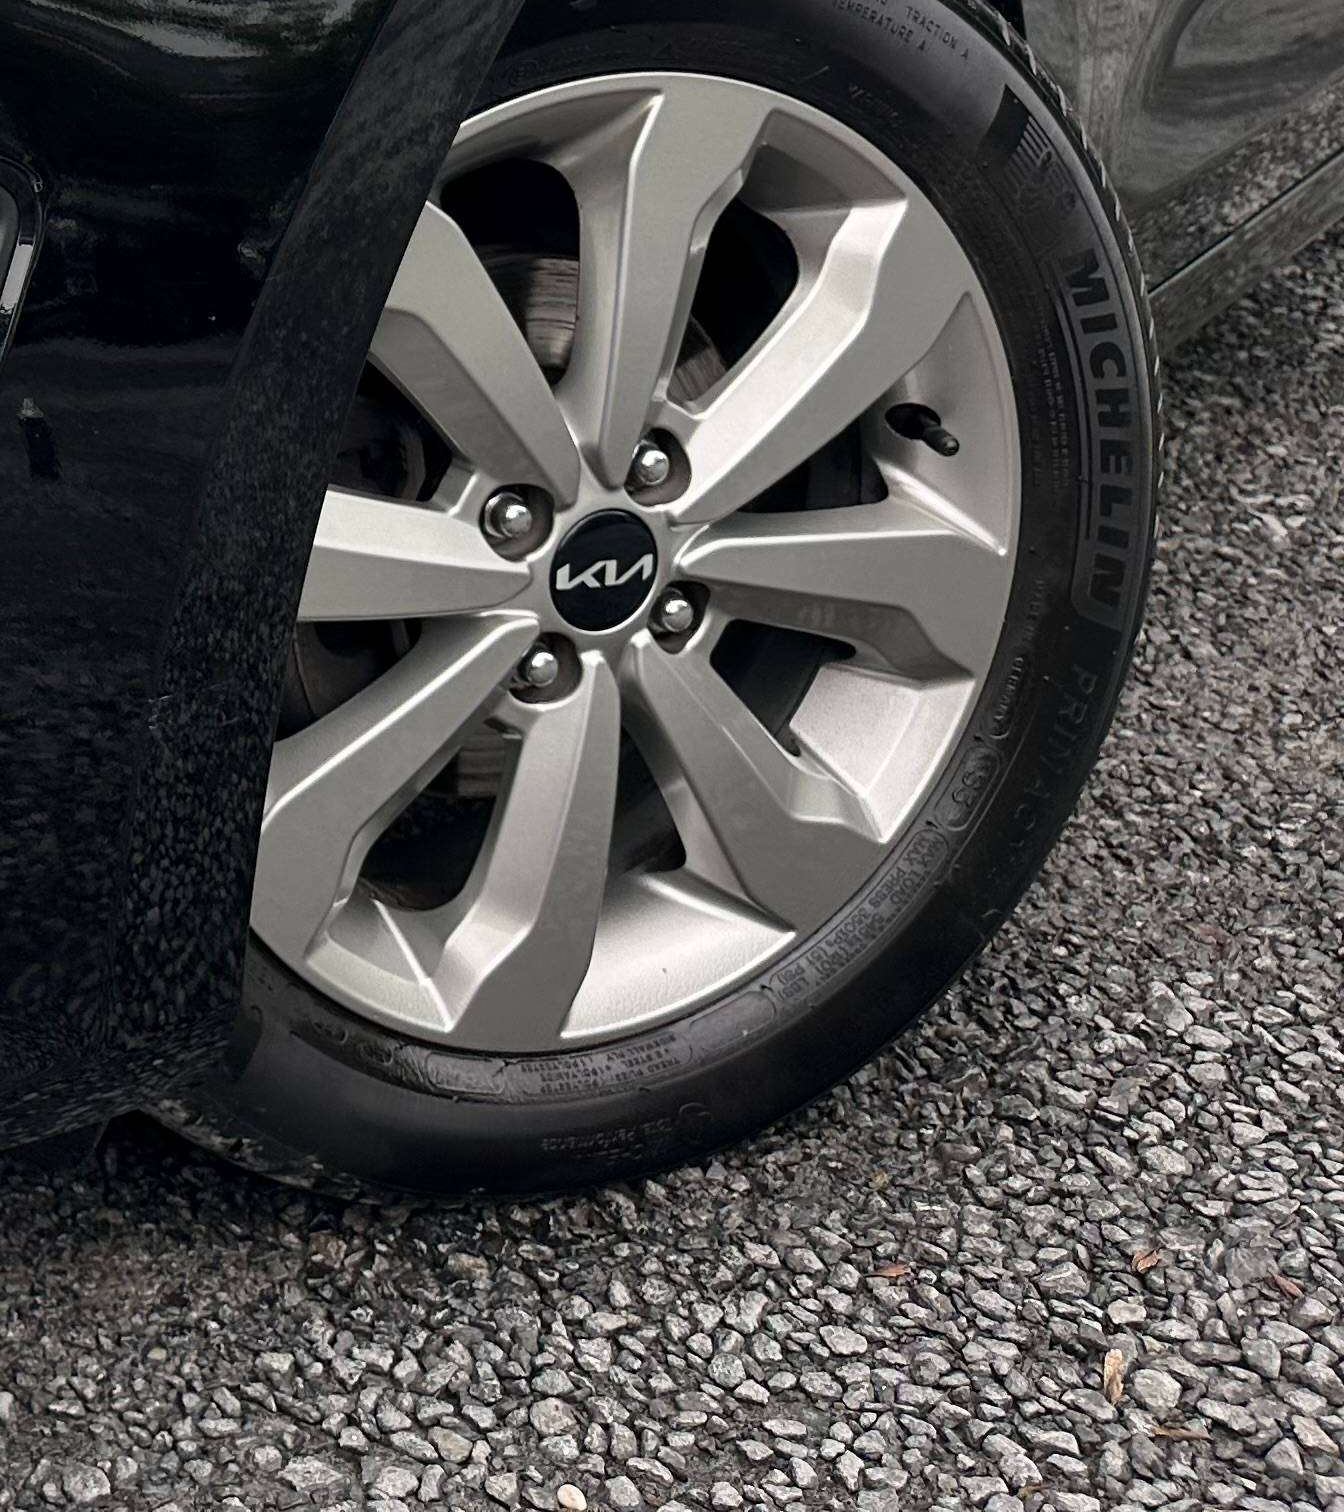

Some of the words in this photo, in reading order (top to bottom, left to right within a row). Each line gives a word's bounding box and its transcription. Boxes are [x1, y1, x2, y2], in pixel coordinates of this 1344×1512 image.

[906, 6, 958, 49] TRACTION
[1060, 248, 1132, 607] MICHELIN
[555, 553, 653, 590] KIA
